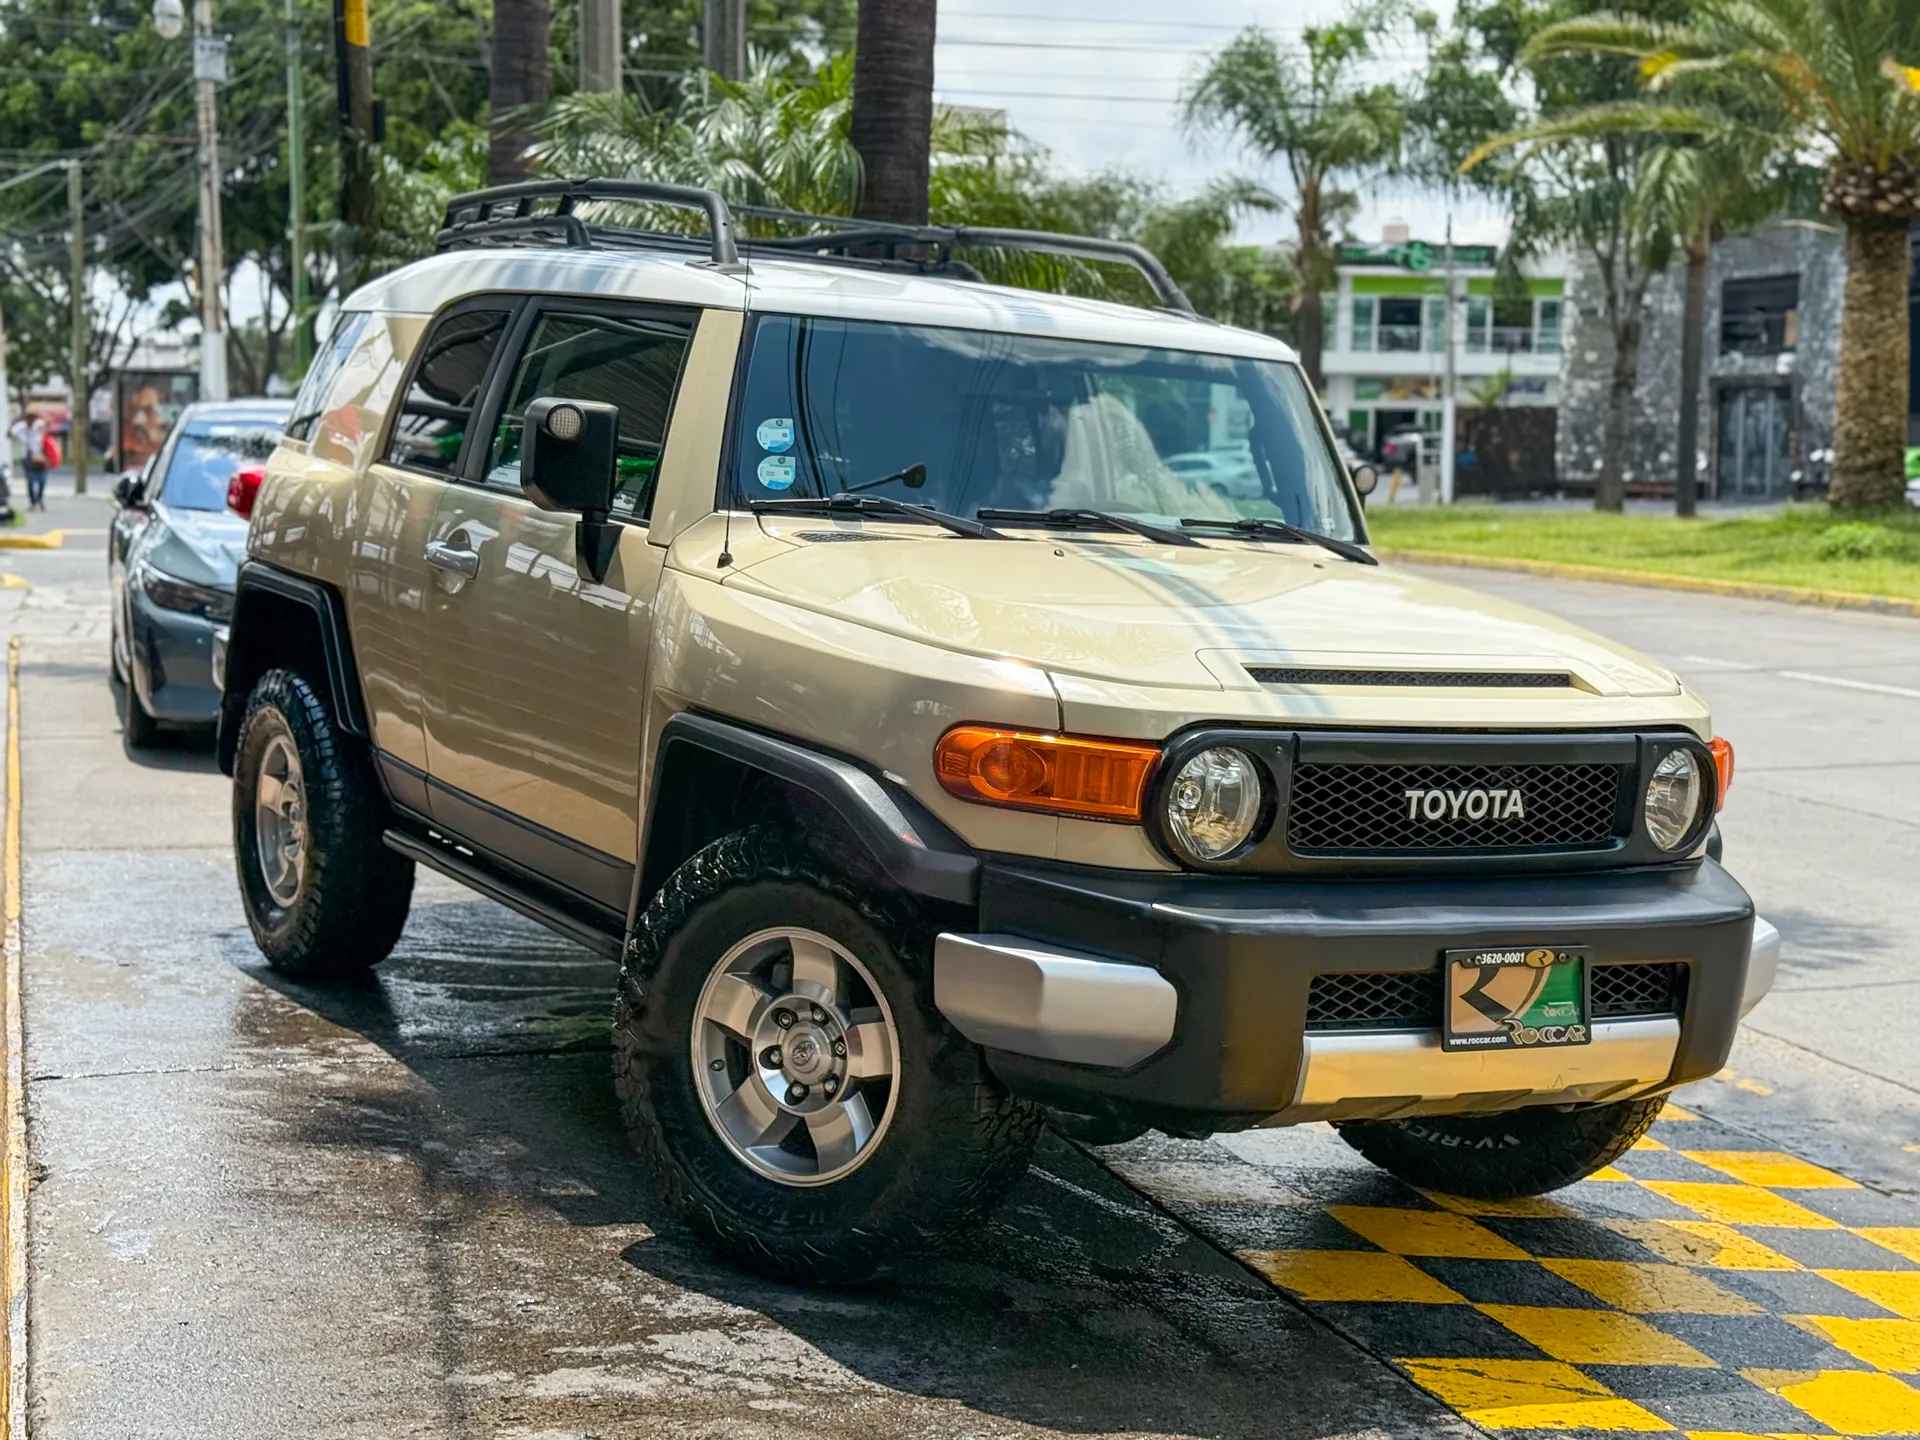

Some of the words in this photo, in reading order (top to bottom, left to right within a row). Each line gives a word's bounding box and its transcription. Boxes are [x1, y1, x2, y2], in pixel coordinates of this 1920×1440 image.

[1405, 789, 1525, 820] TOYOTA
[1480, 952, 1525, 965] 3620-0001
[1449, 1035, 1507, 1046] www.roccar.com
[1502, 1019, 1586, 1046] ROCCAR
